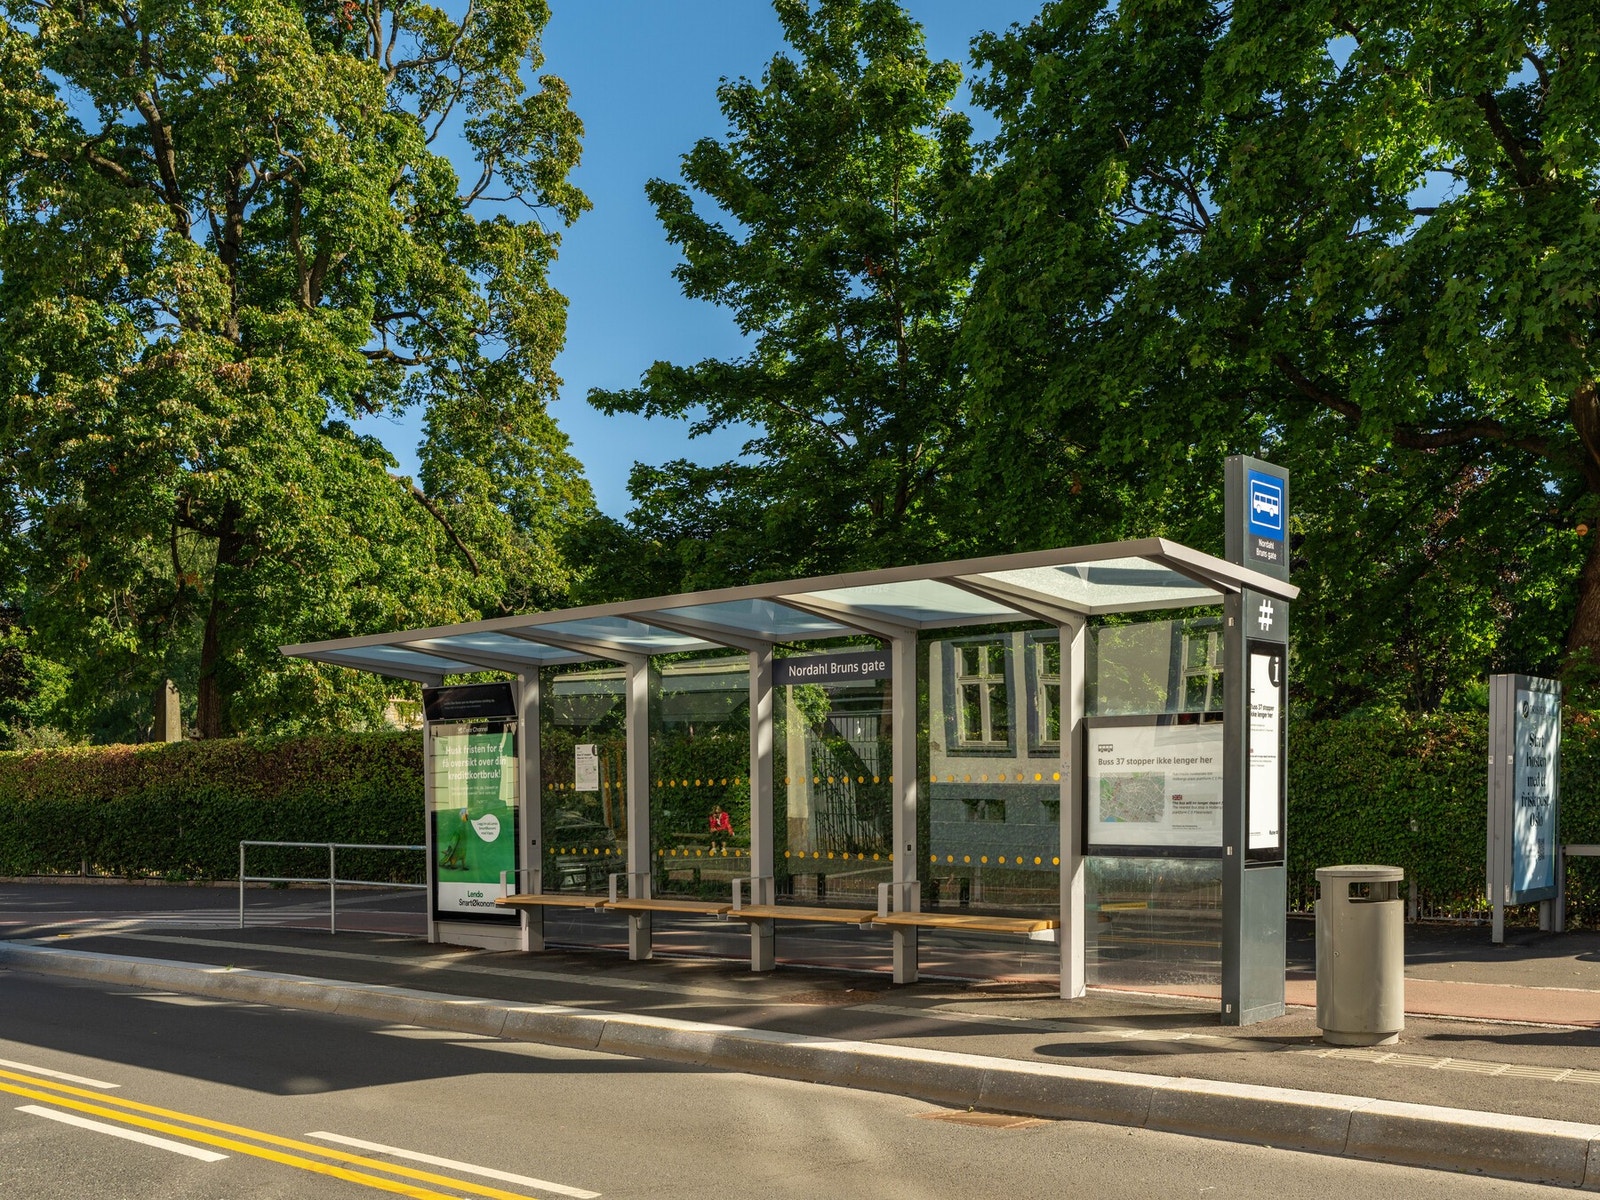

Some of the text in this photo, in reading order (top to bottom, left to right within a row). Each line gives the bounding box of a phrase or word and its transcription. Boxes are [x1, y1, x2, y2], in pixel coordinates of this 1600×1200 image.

[1258, 538, 1275, 550] Nordahl
[1256, 547, 1277, 561] Bruns gate
[788, 660, 886, 677] Nordahl Bruns gate
[1529, 732, 1545, 748] Start
[445, 745, 461, 755] Husk
[463, 744, 485, 755] fristen
[487, 743, 497, 753] for
[443, 756, 507, 769] få oversikt over din
[1098, 755, 1213, 767] Buss 37 stopper ikke lenger her
[467, 890, 484, 899] Lendo
[459, 898, 495, 908] SmartØkonom
